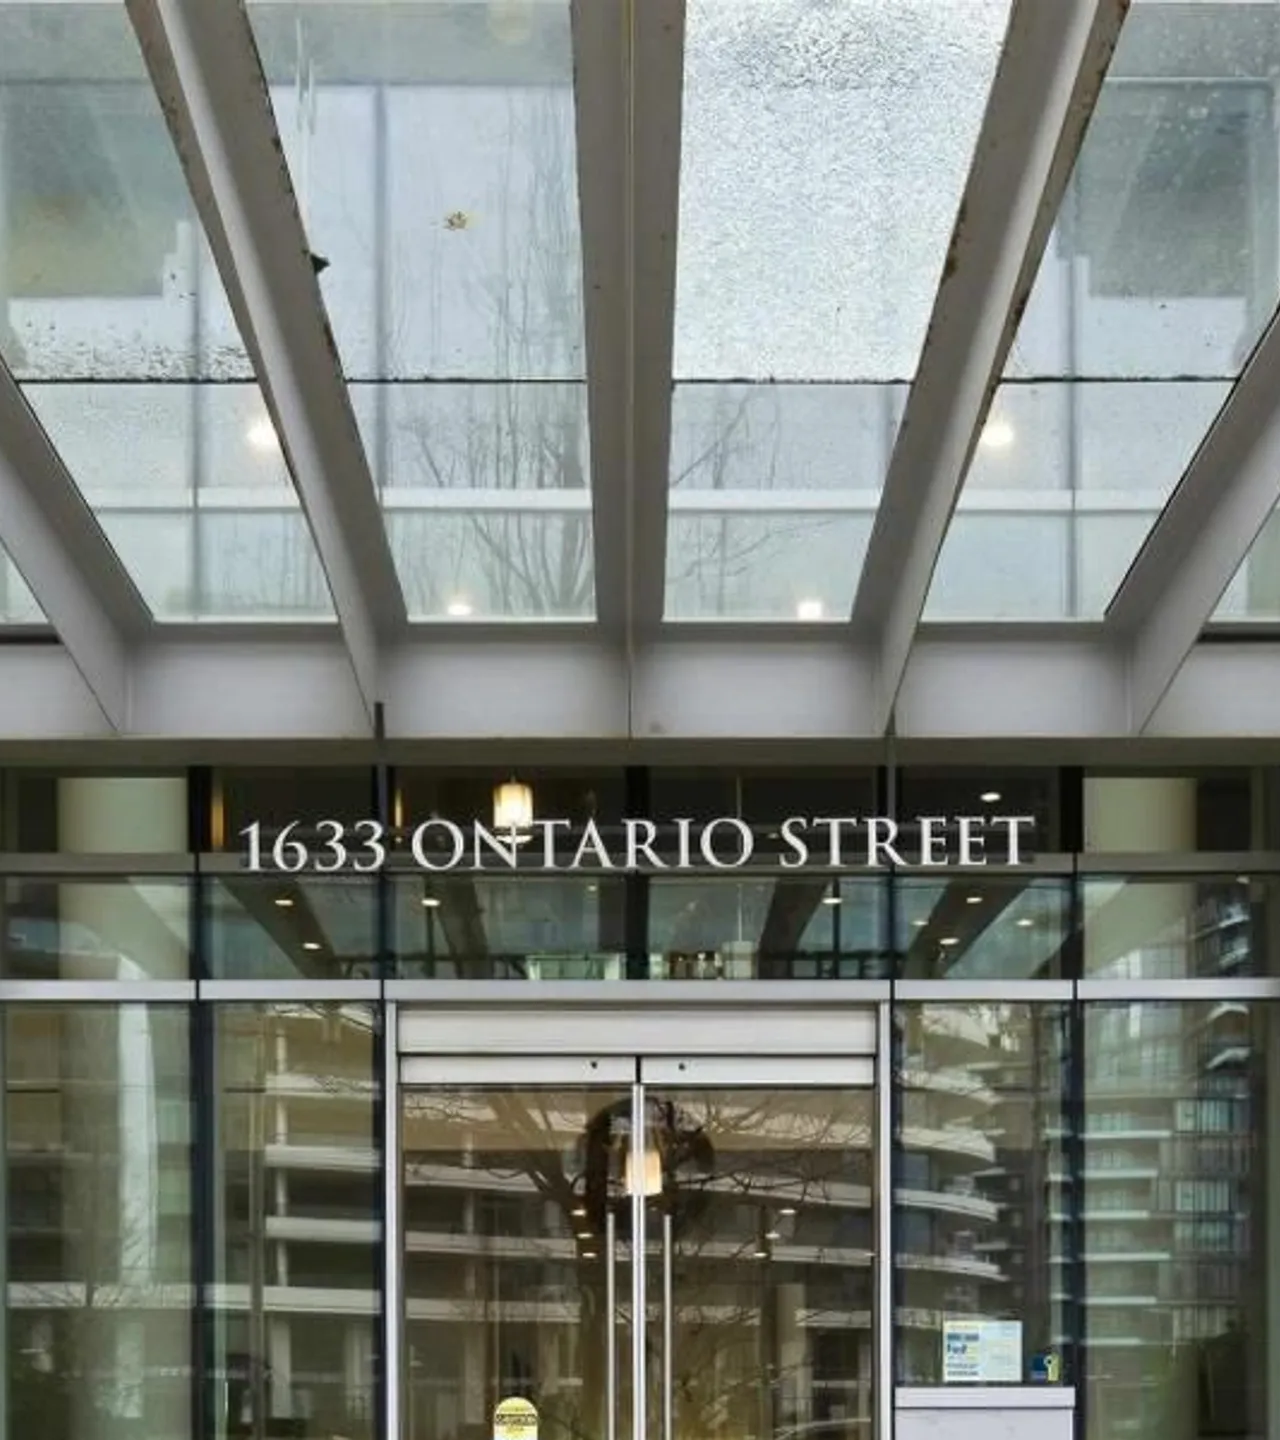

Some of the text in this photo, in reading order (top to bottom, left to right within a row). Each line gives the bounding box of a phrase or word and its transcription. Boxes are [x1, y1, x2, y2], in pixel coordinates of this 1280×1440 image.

[239, 815, 1036, 873] 1633 ONTARIO STREET
